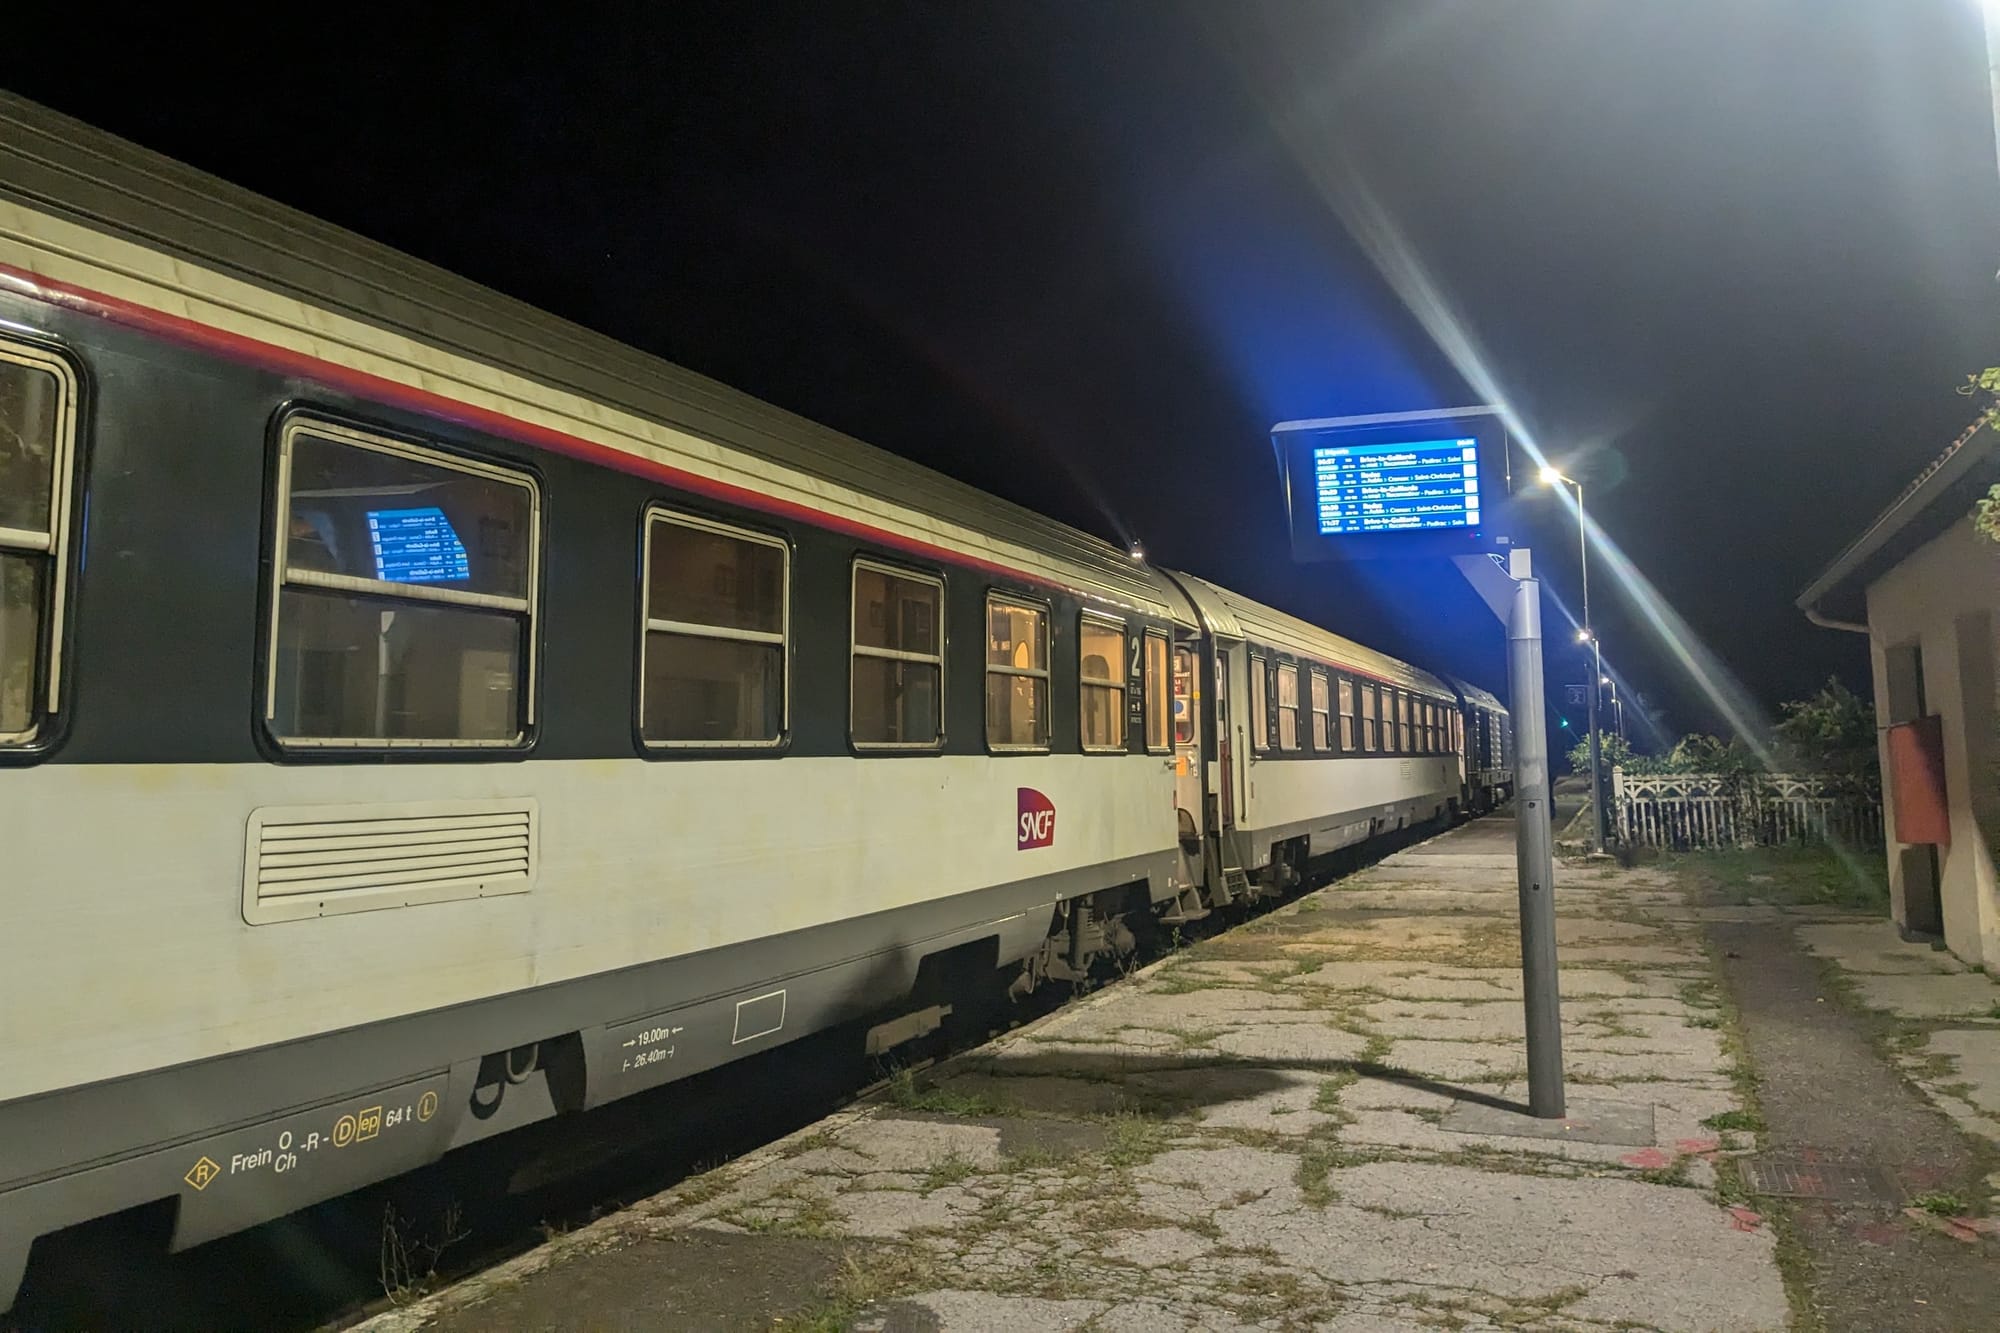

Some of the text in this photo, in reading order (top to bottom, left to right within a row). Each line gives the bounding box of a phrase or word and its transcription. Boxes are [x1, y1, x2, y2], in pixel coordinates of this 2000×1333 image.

[1131, 636, 1140, 677] 2
[1019, 810, 1054, 842] SNCF
[638, 1028, 669, 1046] 19.00m
[634, 1049, 667, 1068] 26.40m
[230, 1149, 272, 1174] Frein
[360, 1114, 378, 1133] ep
[386, 1109, 402, 1128] 64
[406, 1108, 412, 1122] t
[274, 1152, 297, 1173] Ch
